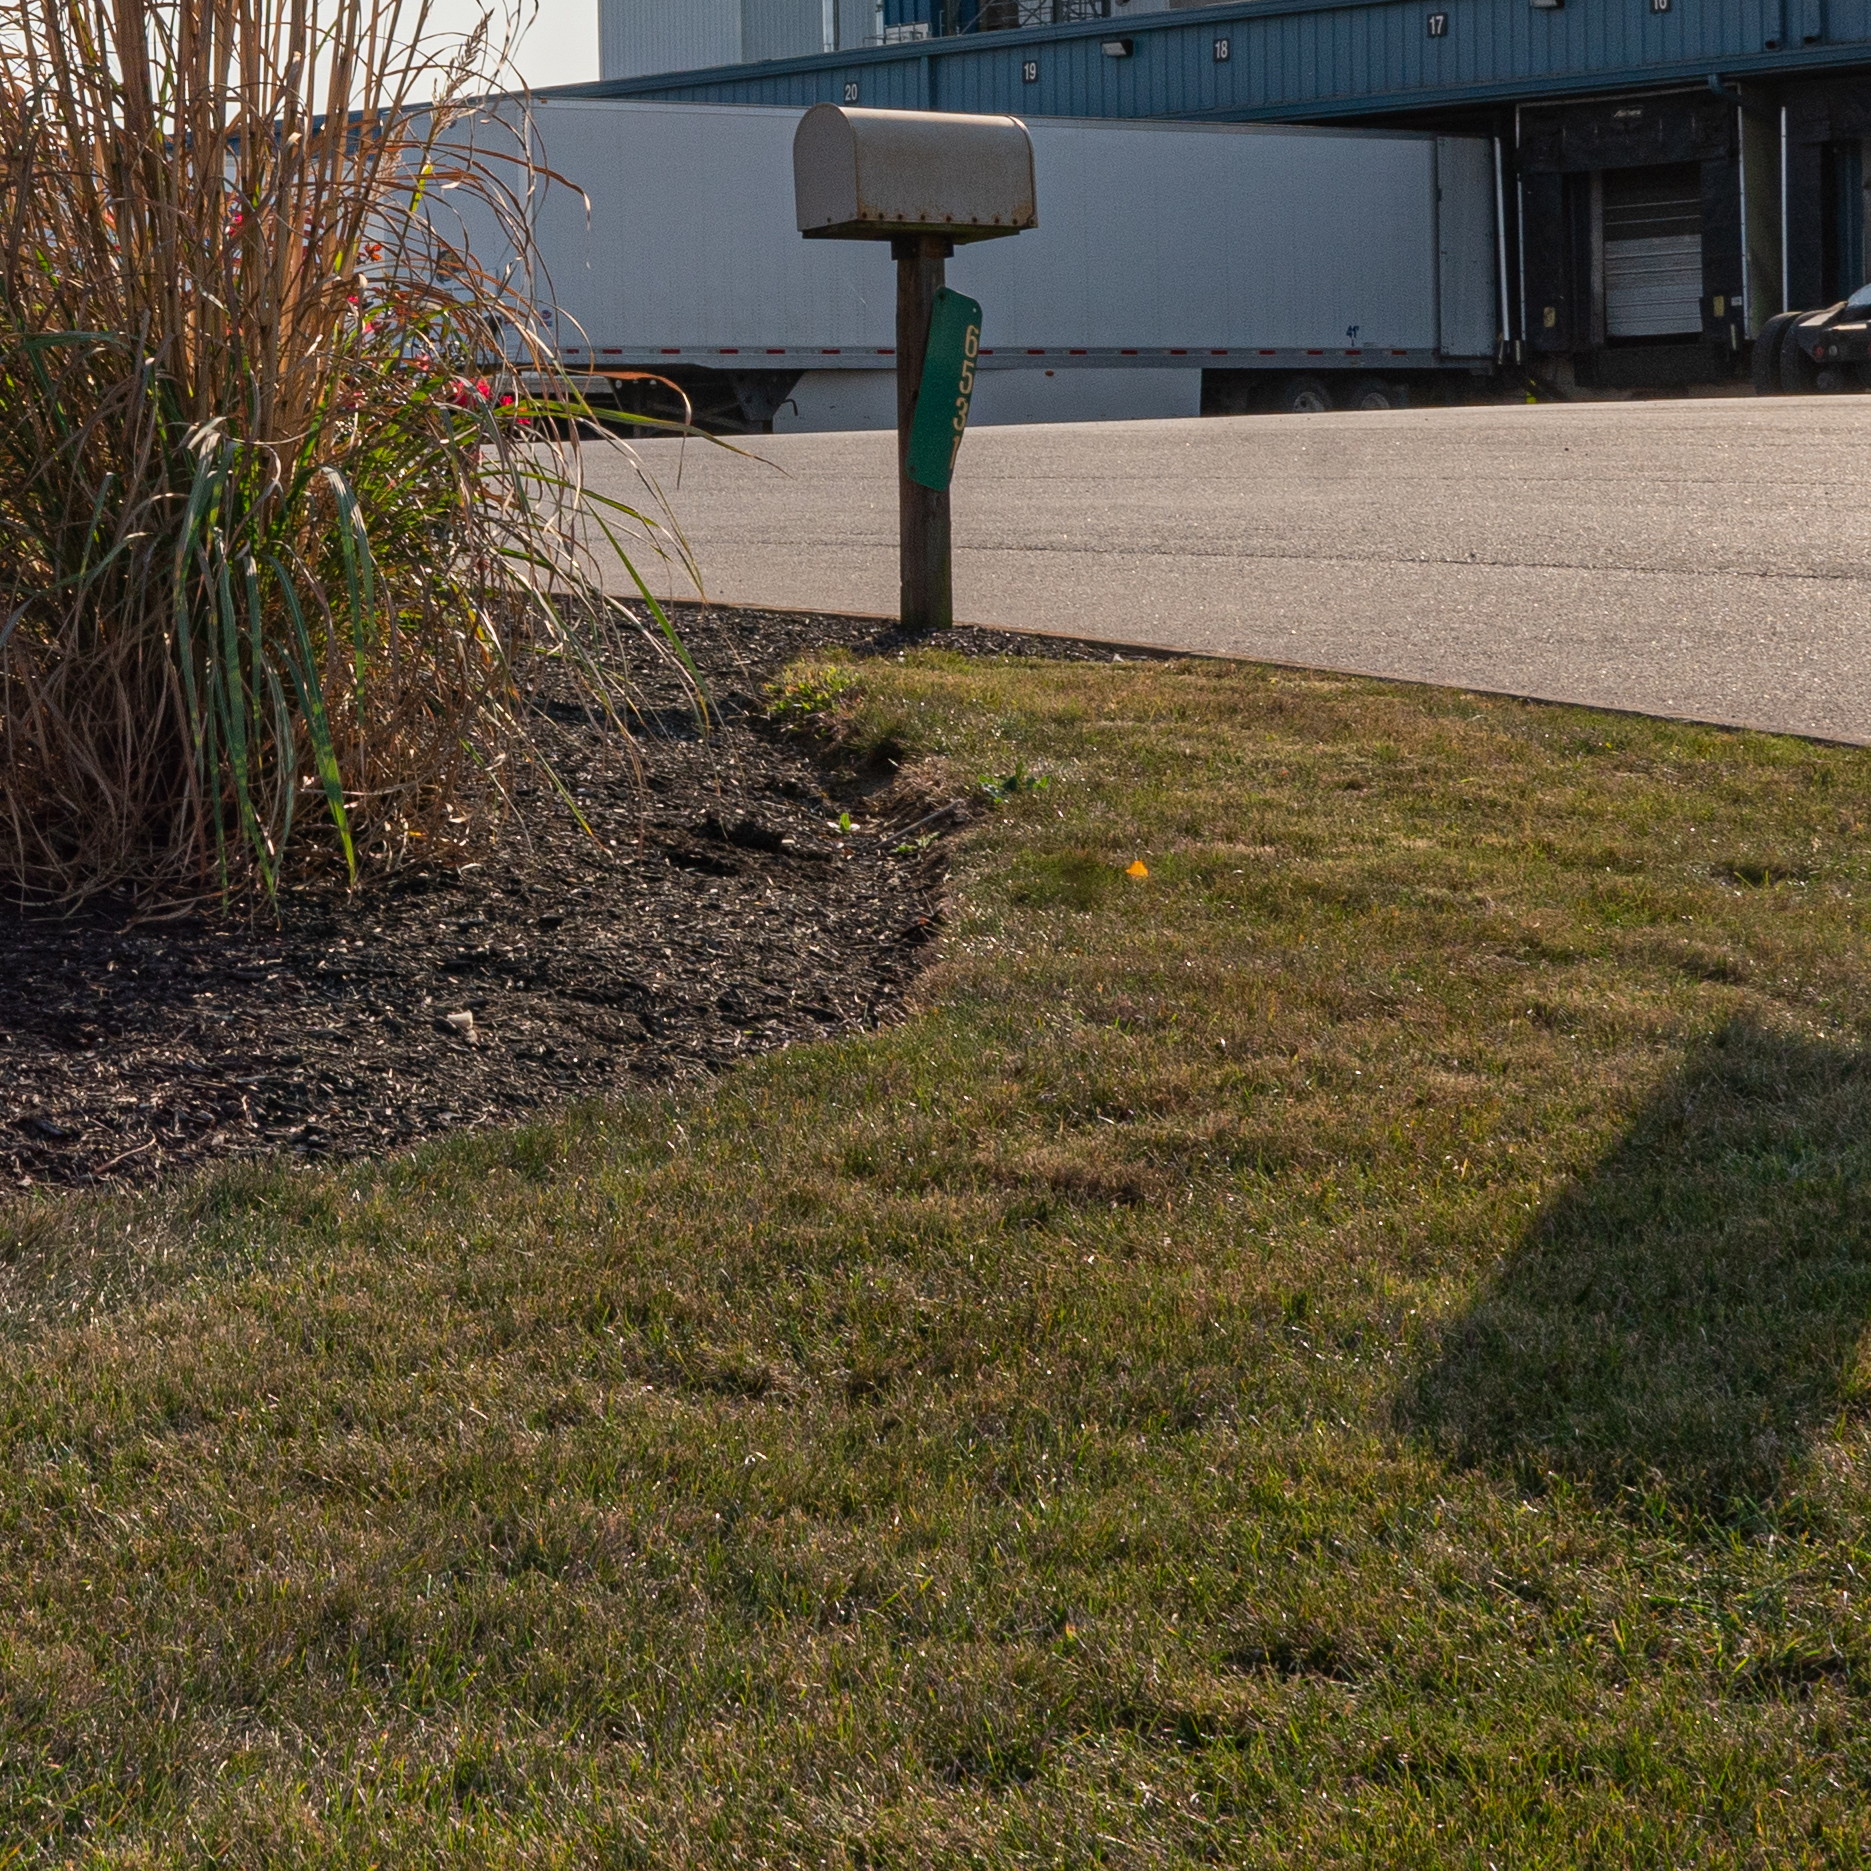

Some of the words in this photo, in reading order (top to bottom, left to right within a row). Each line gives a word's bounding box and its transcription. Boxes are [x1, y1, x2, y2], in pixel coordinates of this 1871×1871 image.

[1429, 15, 1445, 35] 17
[1215, 40, 1228, 58] 18
[1024, 62, 1037, 80] 19
[845, 83, 858, 101] 20
[948, 324, 980, 471] 6531
